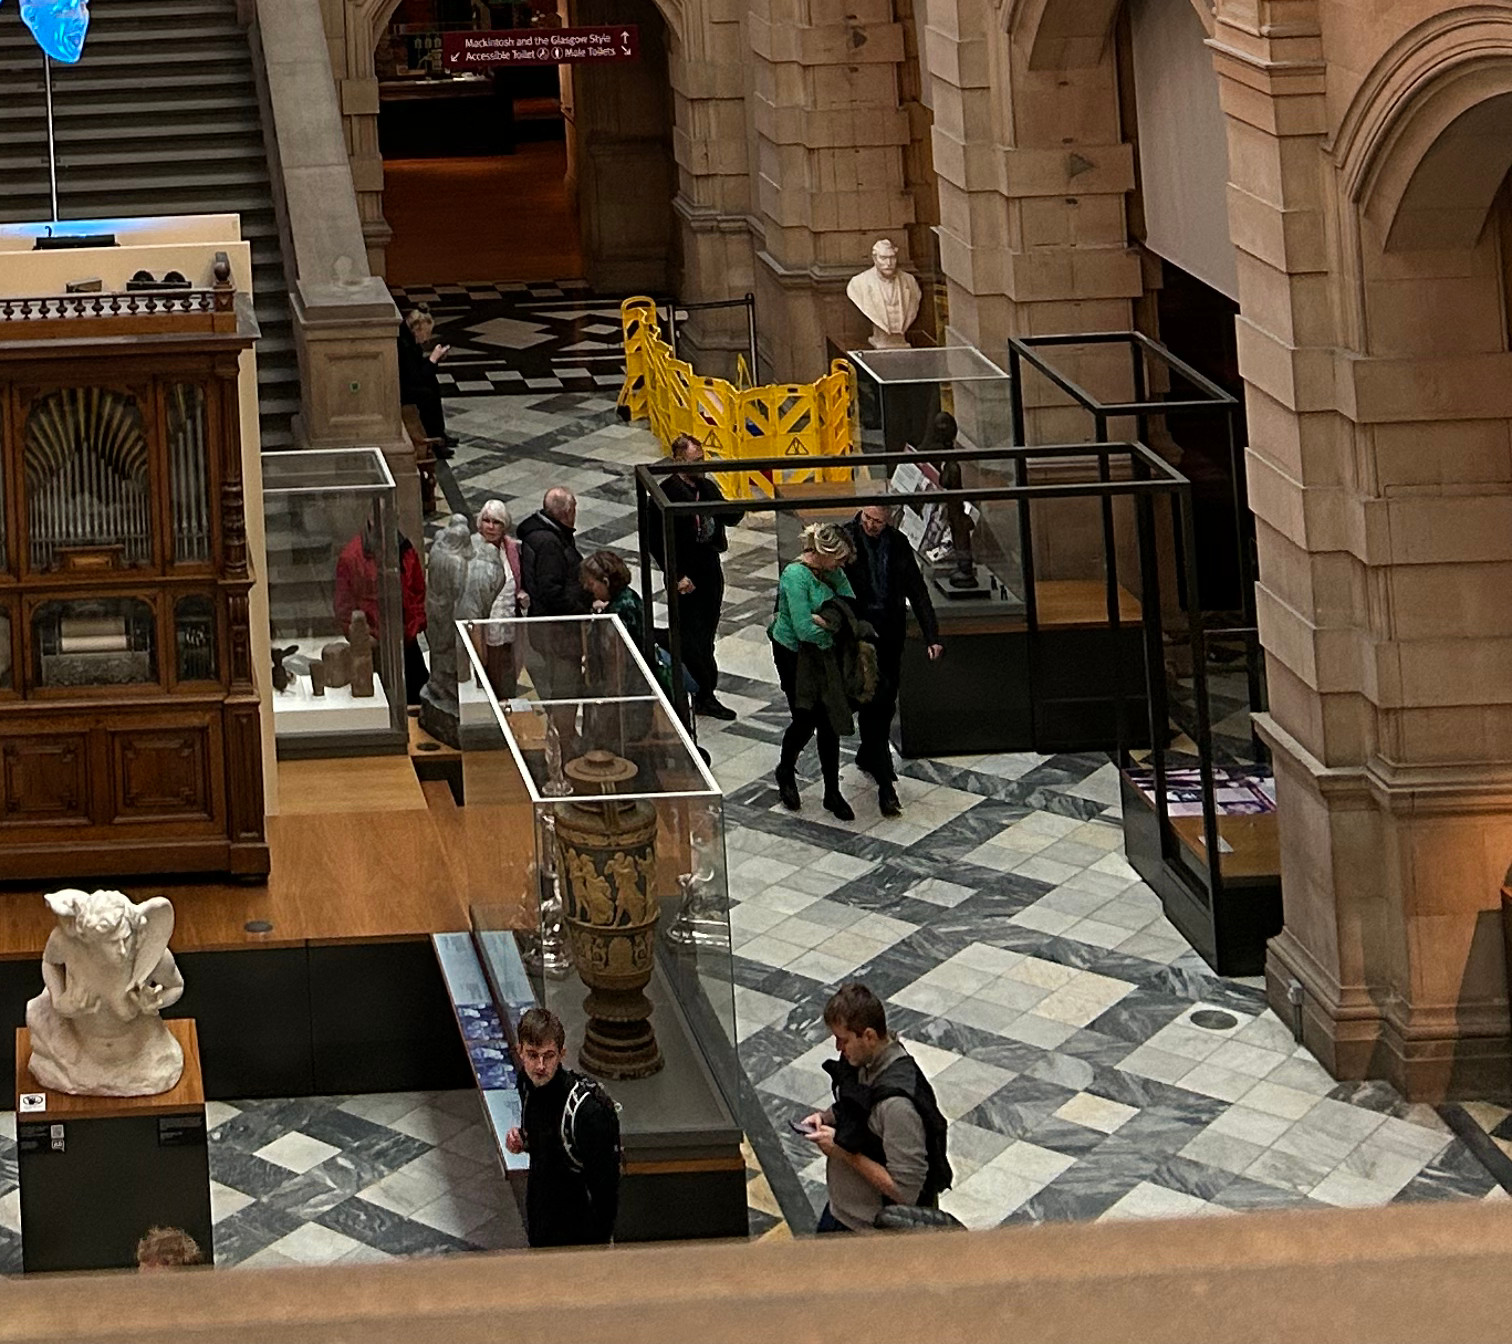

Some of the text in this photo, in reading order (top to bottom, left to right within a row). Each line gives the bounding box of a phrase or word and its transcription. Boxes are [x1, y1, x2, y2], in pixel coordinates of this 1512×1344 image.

[464, 33, 612, 48] Mackintosh and the Glasgow Style
[465, 46, 617, 61] Accessible Toilet Male Toilets
